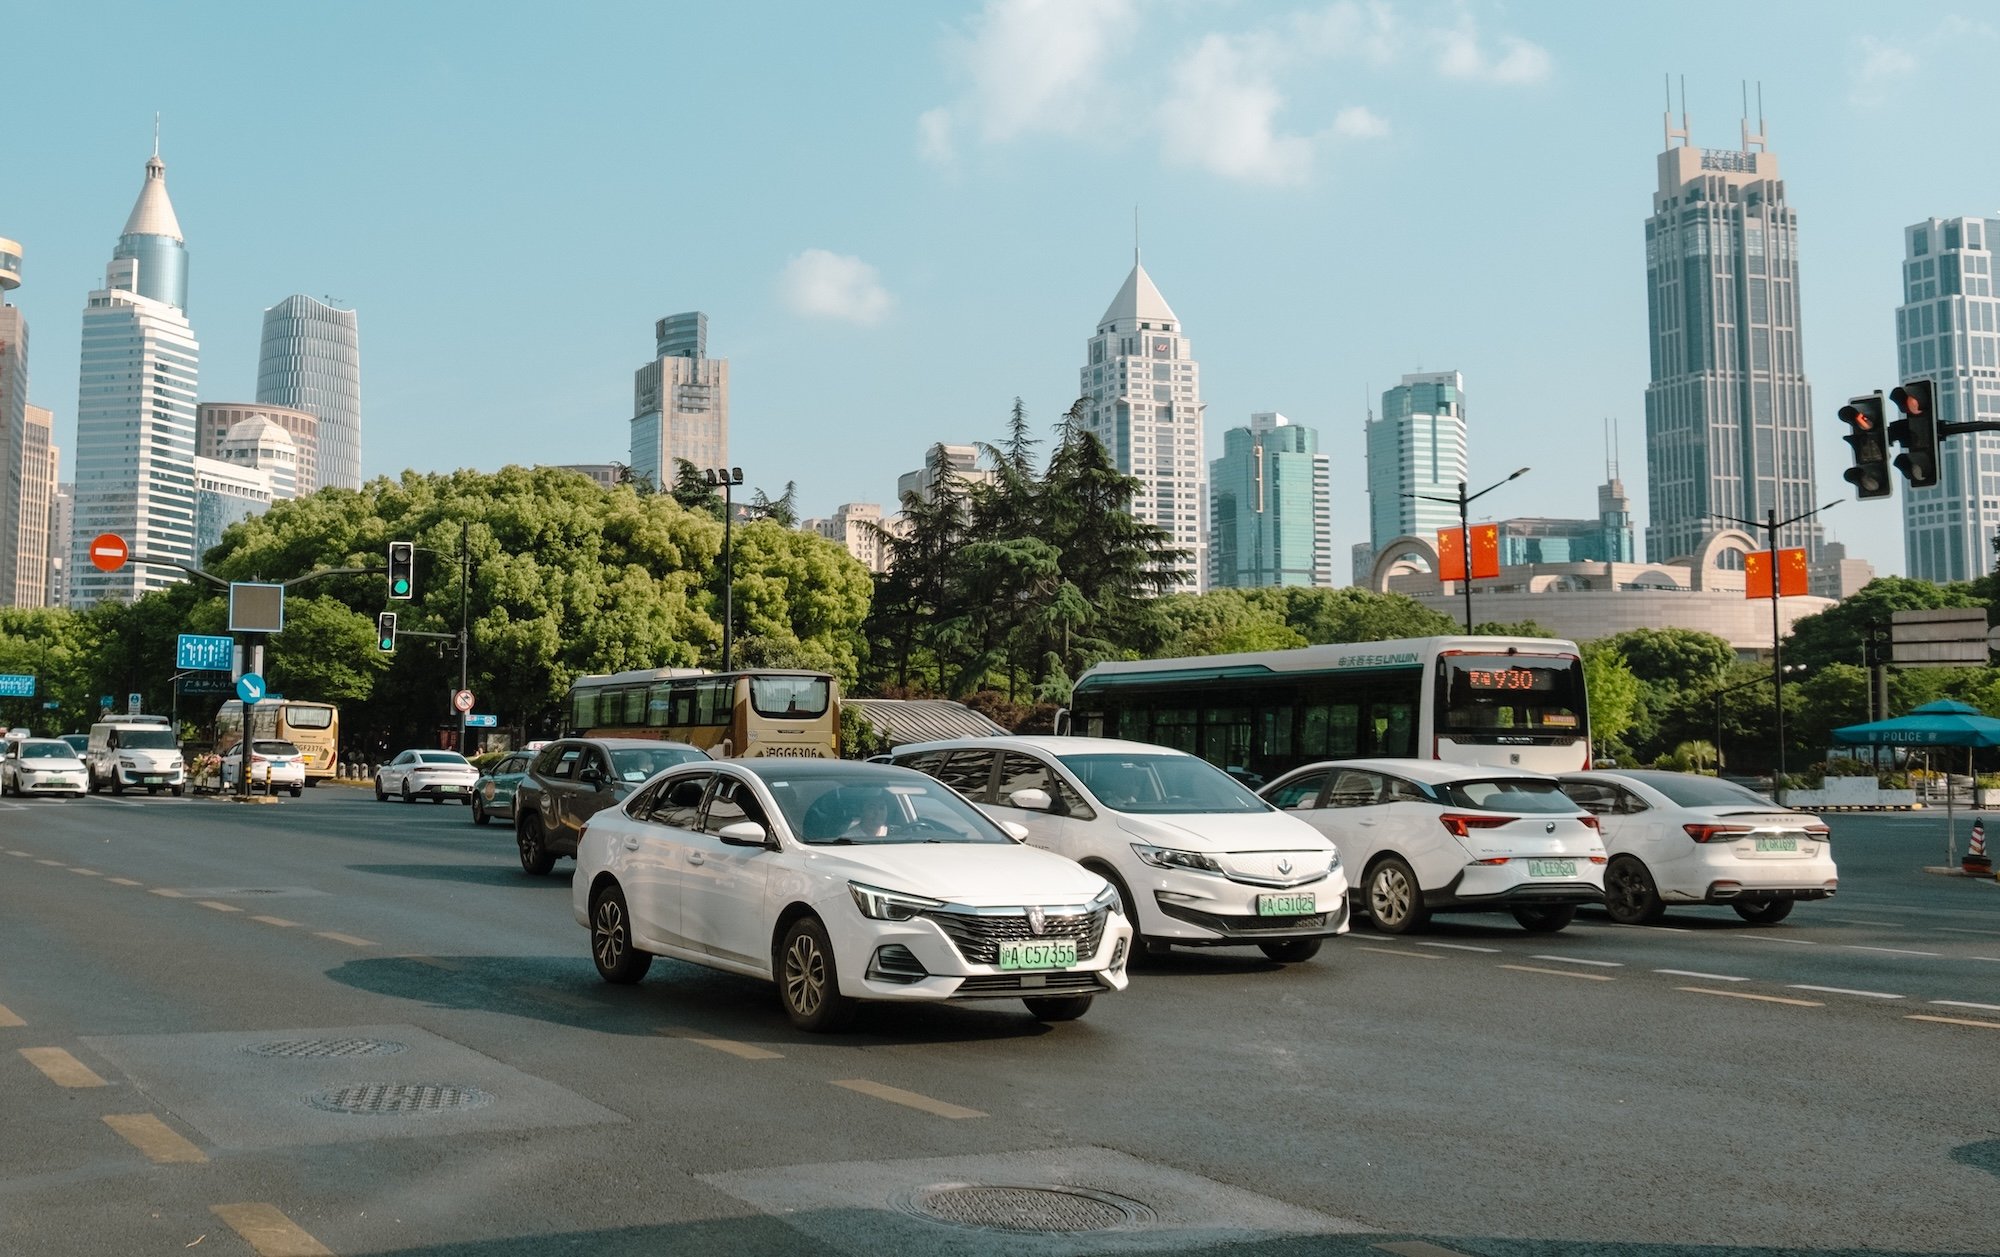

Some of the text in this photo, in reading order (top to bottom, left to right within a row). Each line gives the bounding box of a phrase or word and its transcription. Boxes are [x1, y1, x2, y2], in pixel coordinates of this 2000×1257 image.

[1375, 652, 1419, 665] SUNWIN
[1494, 669, 1533, 689] 930
[1883, 731, 1921, 742] POLICE
